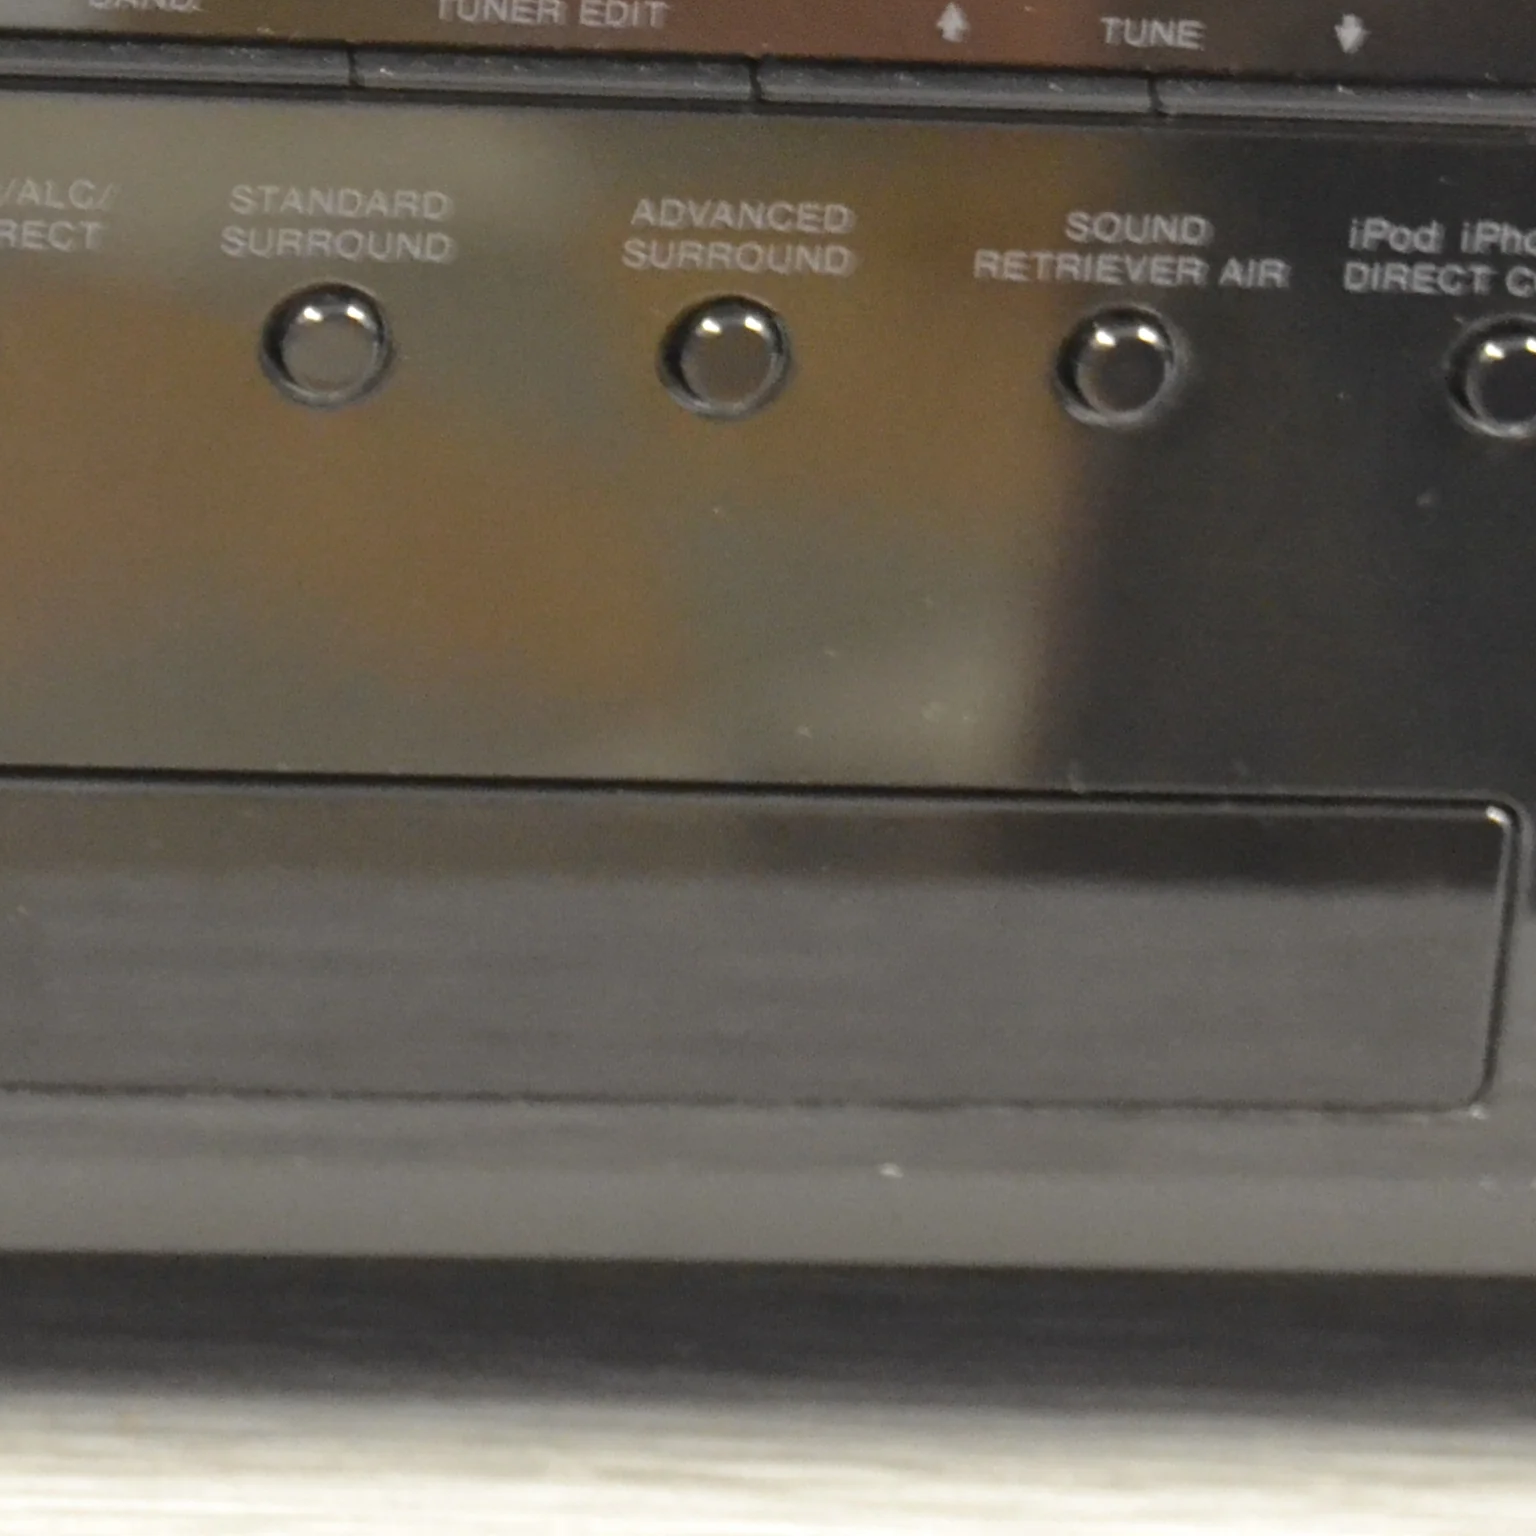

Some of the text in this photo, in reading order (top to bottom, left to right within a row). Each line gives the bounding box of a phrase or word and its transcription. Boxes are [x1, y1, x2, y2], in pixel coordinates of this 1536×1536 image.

[1100, 16, 1206, 51] TUNE
[228, 184, 450, 221] STANDARD
[631, 197, 856, 235] ADVANCED
[220, 225, 452, 262] SURROUND
[1064, 211, 1213, 247] SOUND
[1348, 216, 1444, 255] iPod
[620, 239, 857, 277] SURROUND
[973, 249, 1290, 289] RETRIEVER AIR
[1343, 262, 1495, 296] DIRECT
